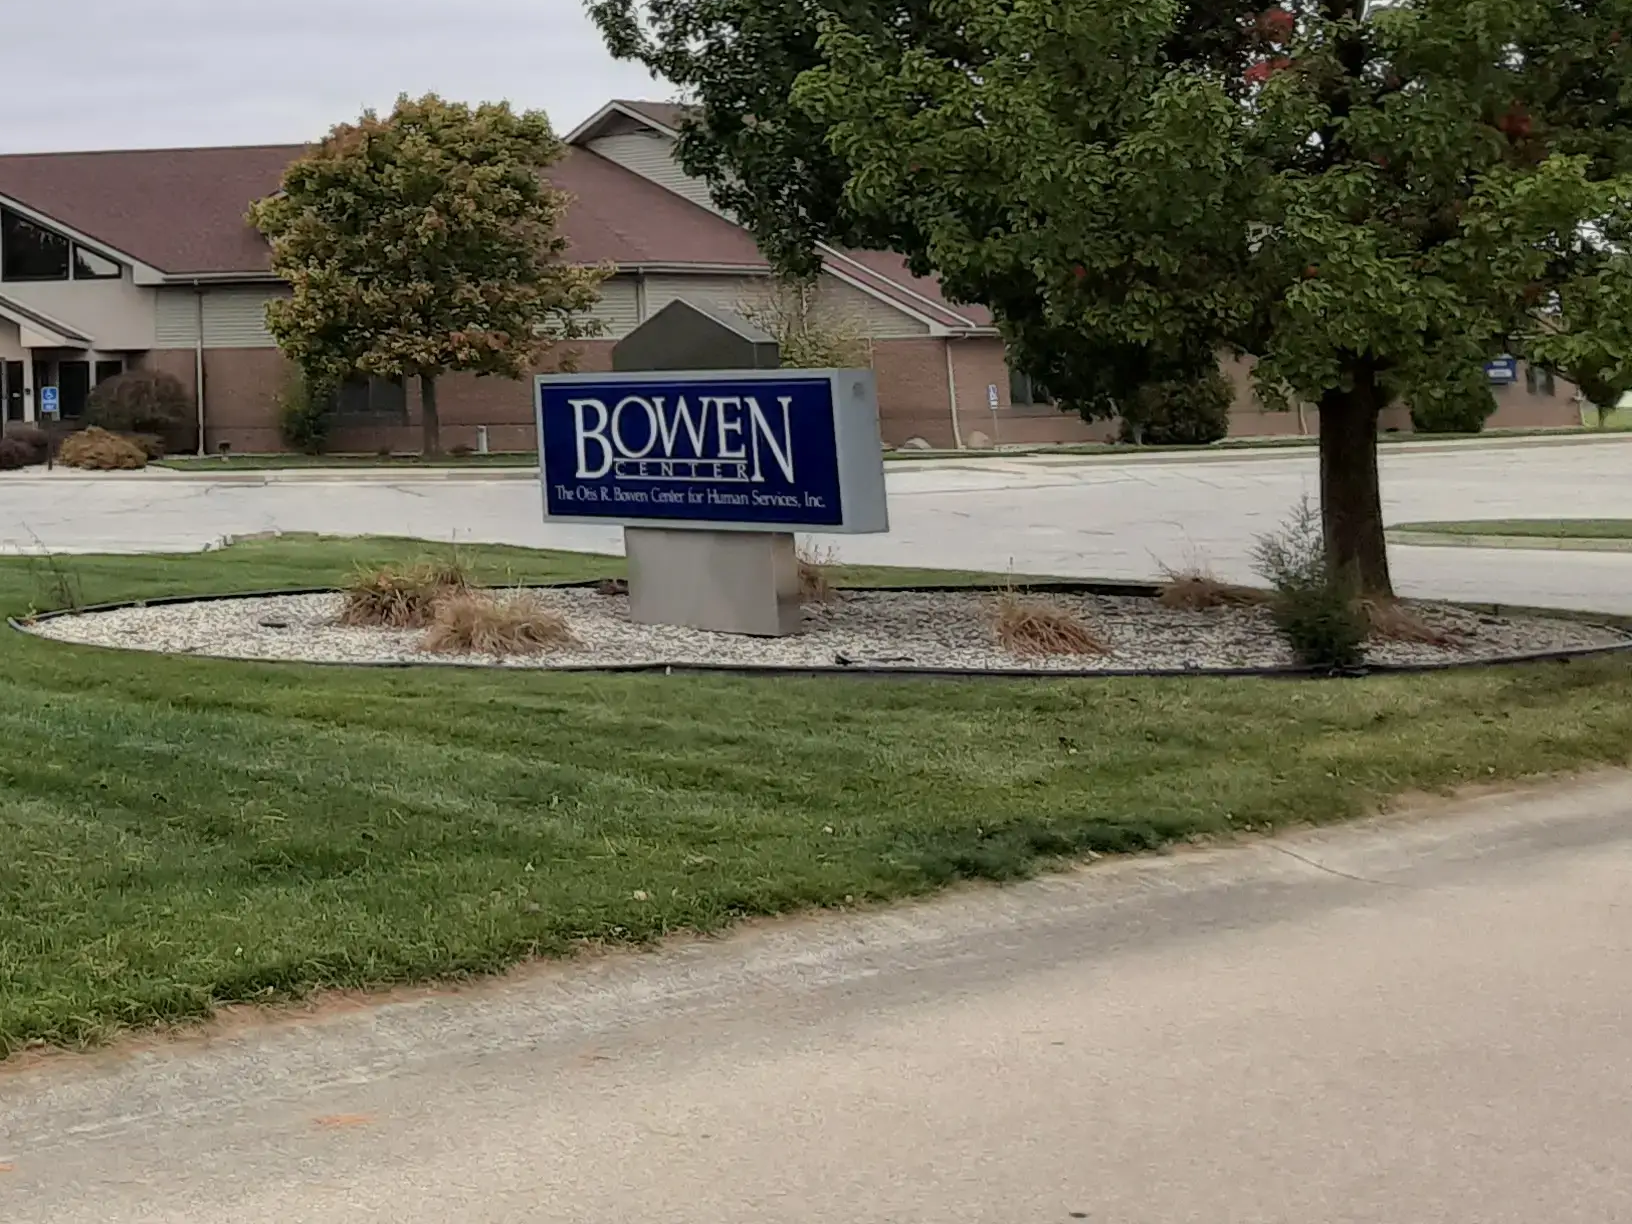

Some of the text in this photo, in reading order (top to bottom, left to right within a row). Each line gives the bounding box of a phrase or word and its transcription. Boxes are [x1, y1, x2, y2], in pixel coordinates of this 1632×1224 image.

[567, 396, 794, 484] BOWEN
[614, 462, 748, 478] CENTER
[554, 484, 574, 501] The
[576, 485, 598, 501] Otis
[613, 487, 649, 502] Bowen
[651, 487, 685, 503] Center
[688, 487, 704, 504] for
[707, 488, 749, 504] Human
[751, 489, 802, 508] Services,
[804, 491, 826, 508] Inc.
